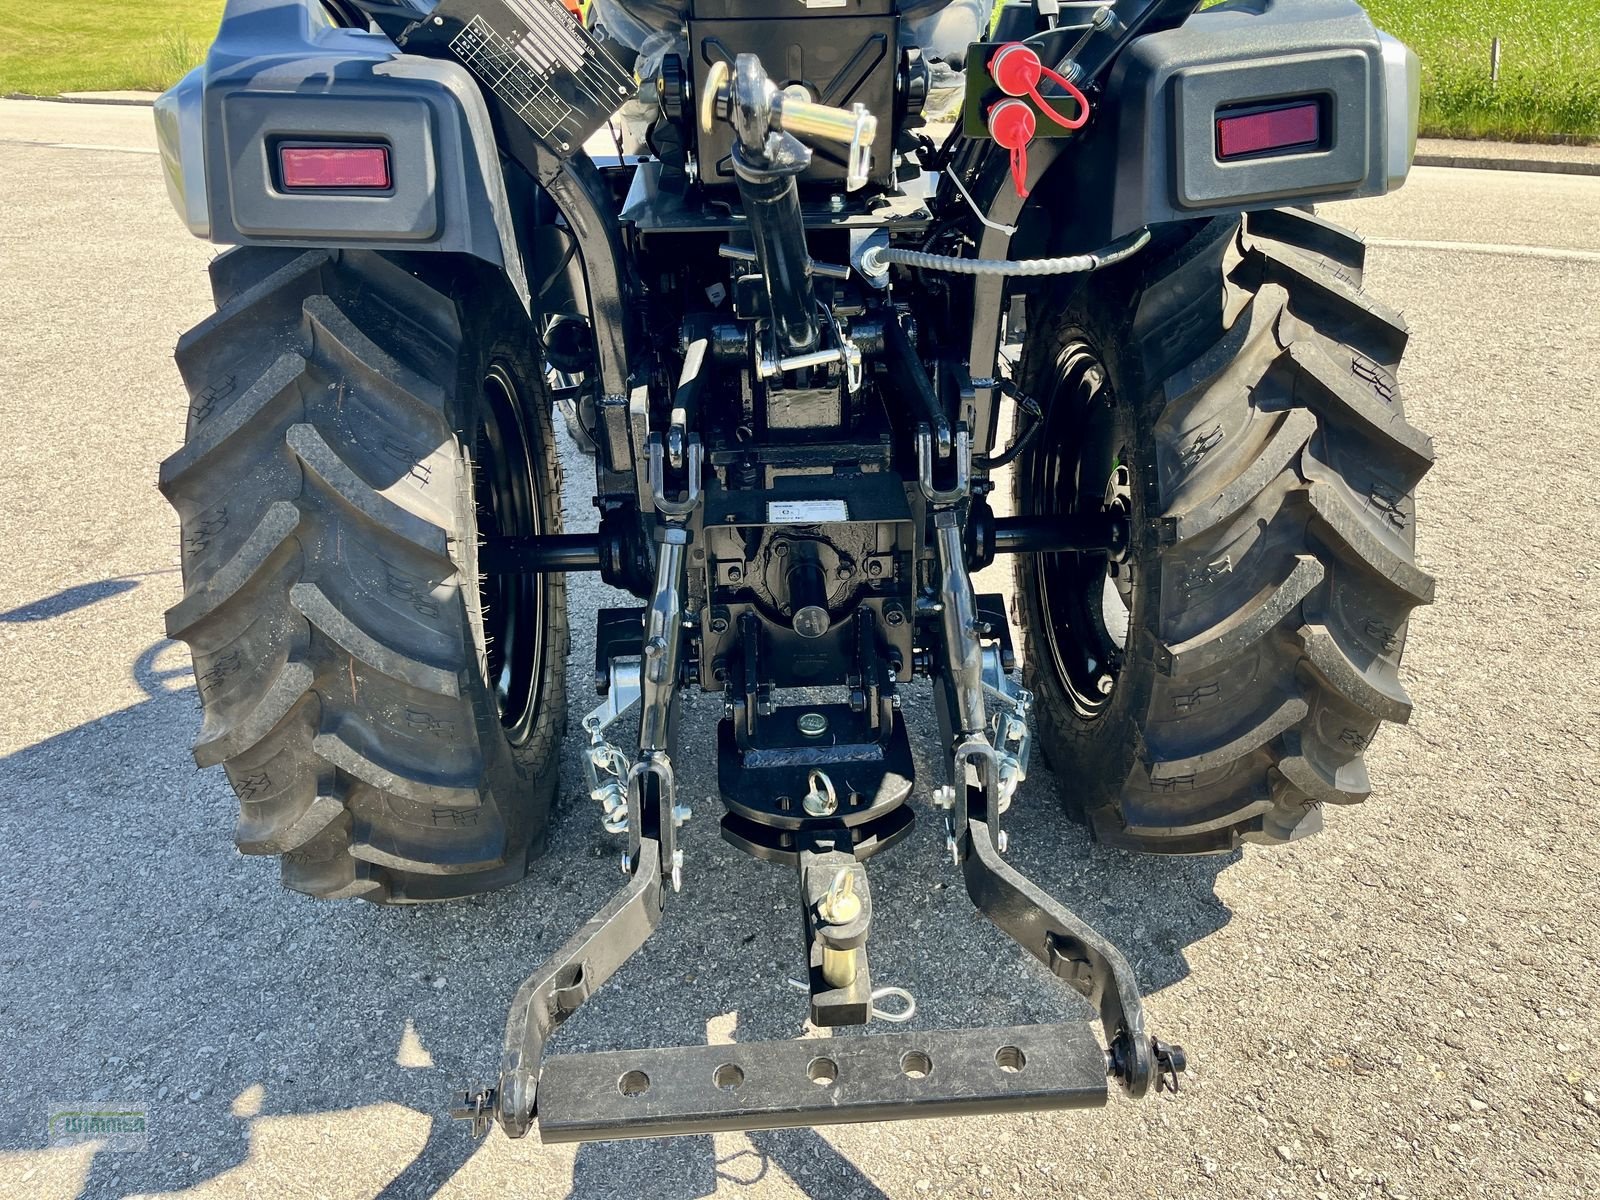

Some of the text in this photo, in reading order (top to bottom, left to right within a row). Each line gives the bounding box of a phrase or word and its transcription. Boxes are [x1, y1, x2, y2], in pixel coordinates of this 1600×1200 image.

[473, 28, 482, 36] B-1
[467, 34, 476, 43] B-2
[456, 47, 465, 56] B-4
